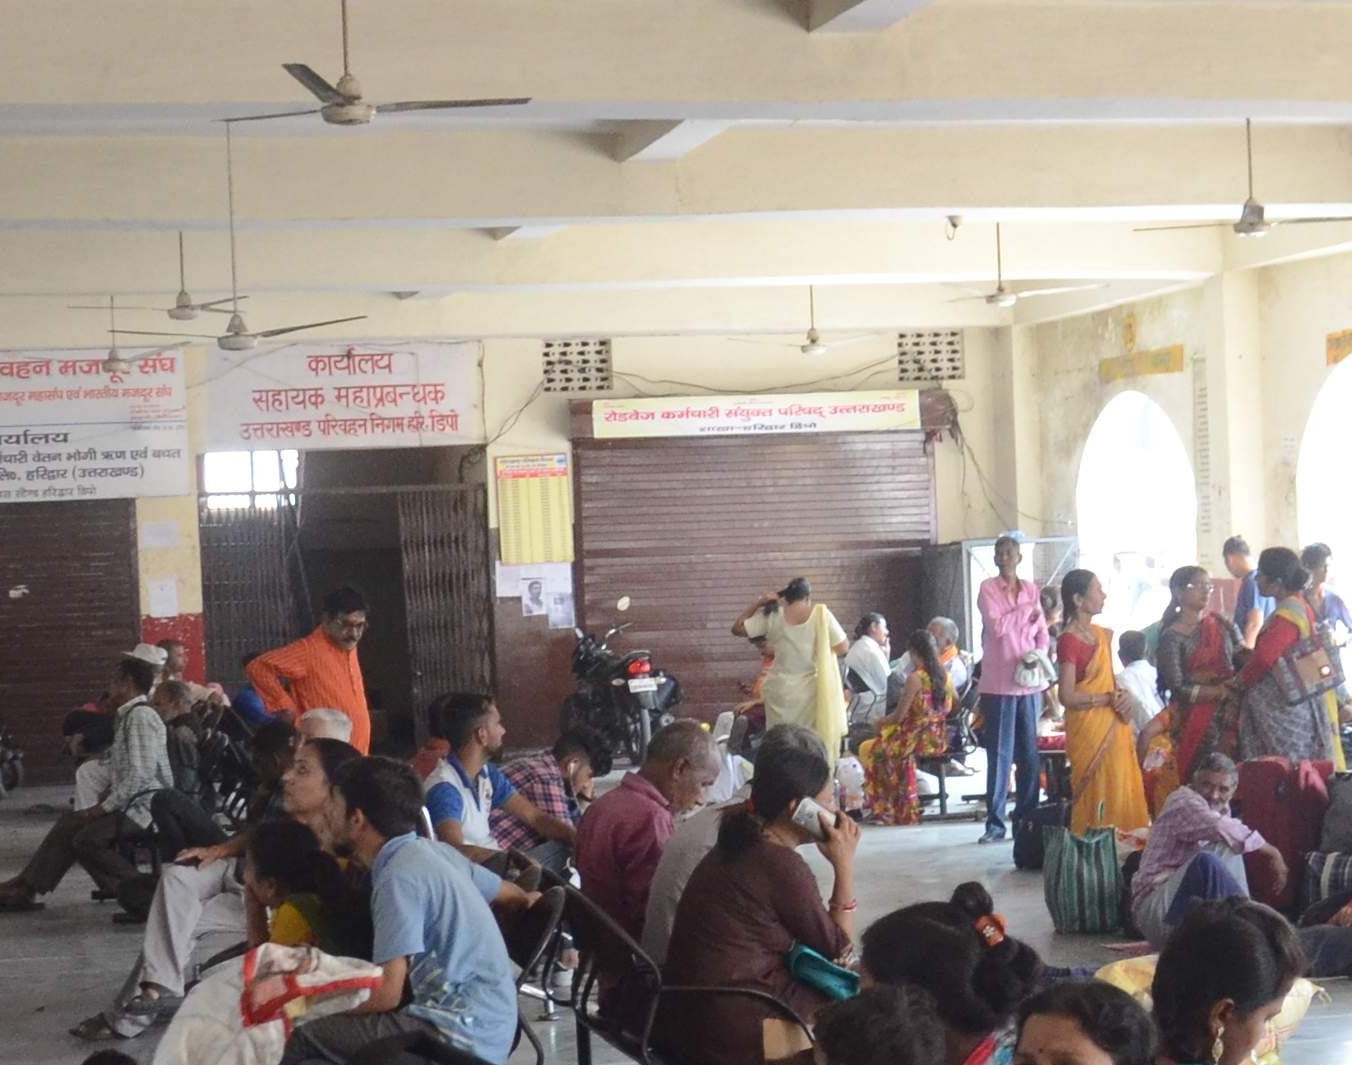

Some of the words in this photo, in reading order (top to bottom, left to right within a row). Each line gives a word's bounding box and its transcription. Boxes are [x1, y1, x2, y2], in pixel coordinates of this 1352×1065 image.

[139, 351, 176, 375] संघ
[306, 345, 394, 376] कार्यालय
[252, 387, 326, 412] सहायक
[333, 383, 445, 409] महाप्रबन्धक
[240, 420, 312, 440] उत्तराखण्ड
[315, 413, 367, 437] परिवहन
[370, 412, 405, 433] निगम
[429, 409, 459, 433] डिपो
[661, 406, 719, 420] कर्मचारी
[66, 447, 96, 462] भोगी
[130, 446, 148, 460] एवं
[26, 465, 68, 481] हरिद्वार
